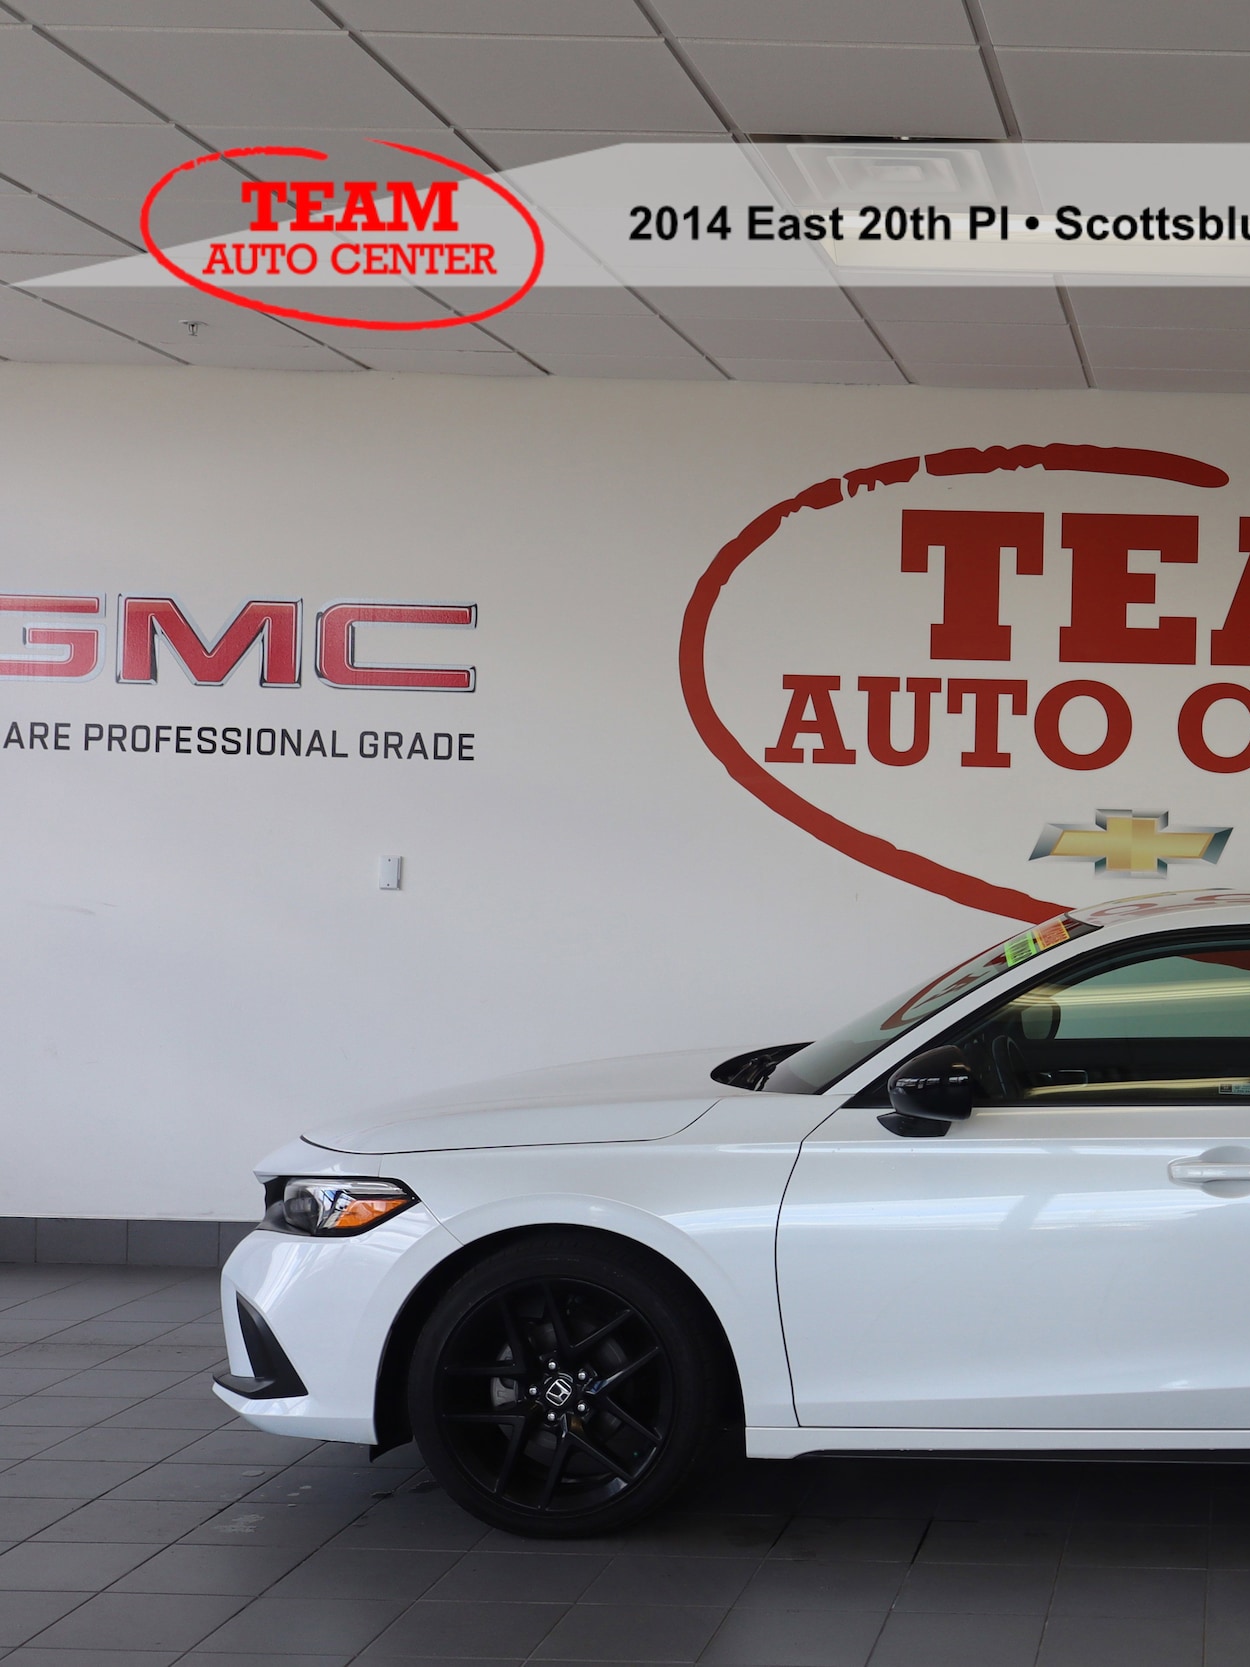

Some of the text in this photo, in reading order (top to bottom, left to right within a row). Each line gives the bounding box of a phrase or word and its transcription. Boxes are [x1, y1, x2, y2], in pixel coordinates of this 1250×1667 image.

[0, 592, 478, 693] GMC
[3, 721, 475, 761] ARE PROFESSIONAL GRADE
[764, 674, 1133, 771] AUTO
